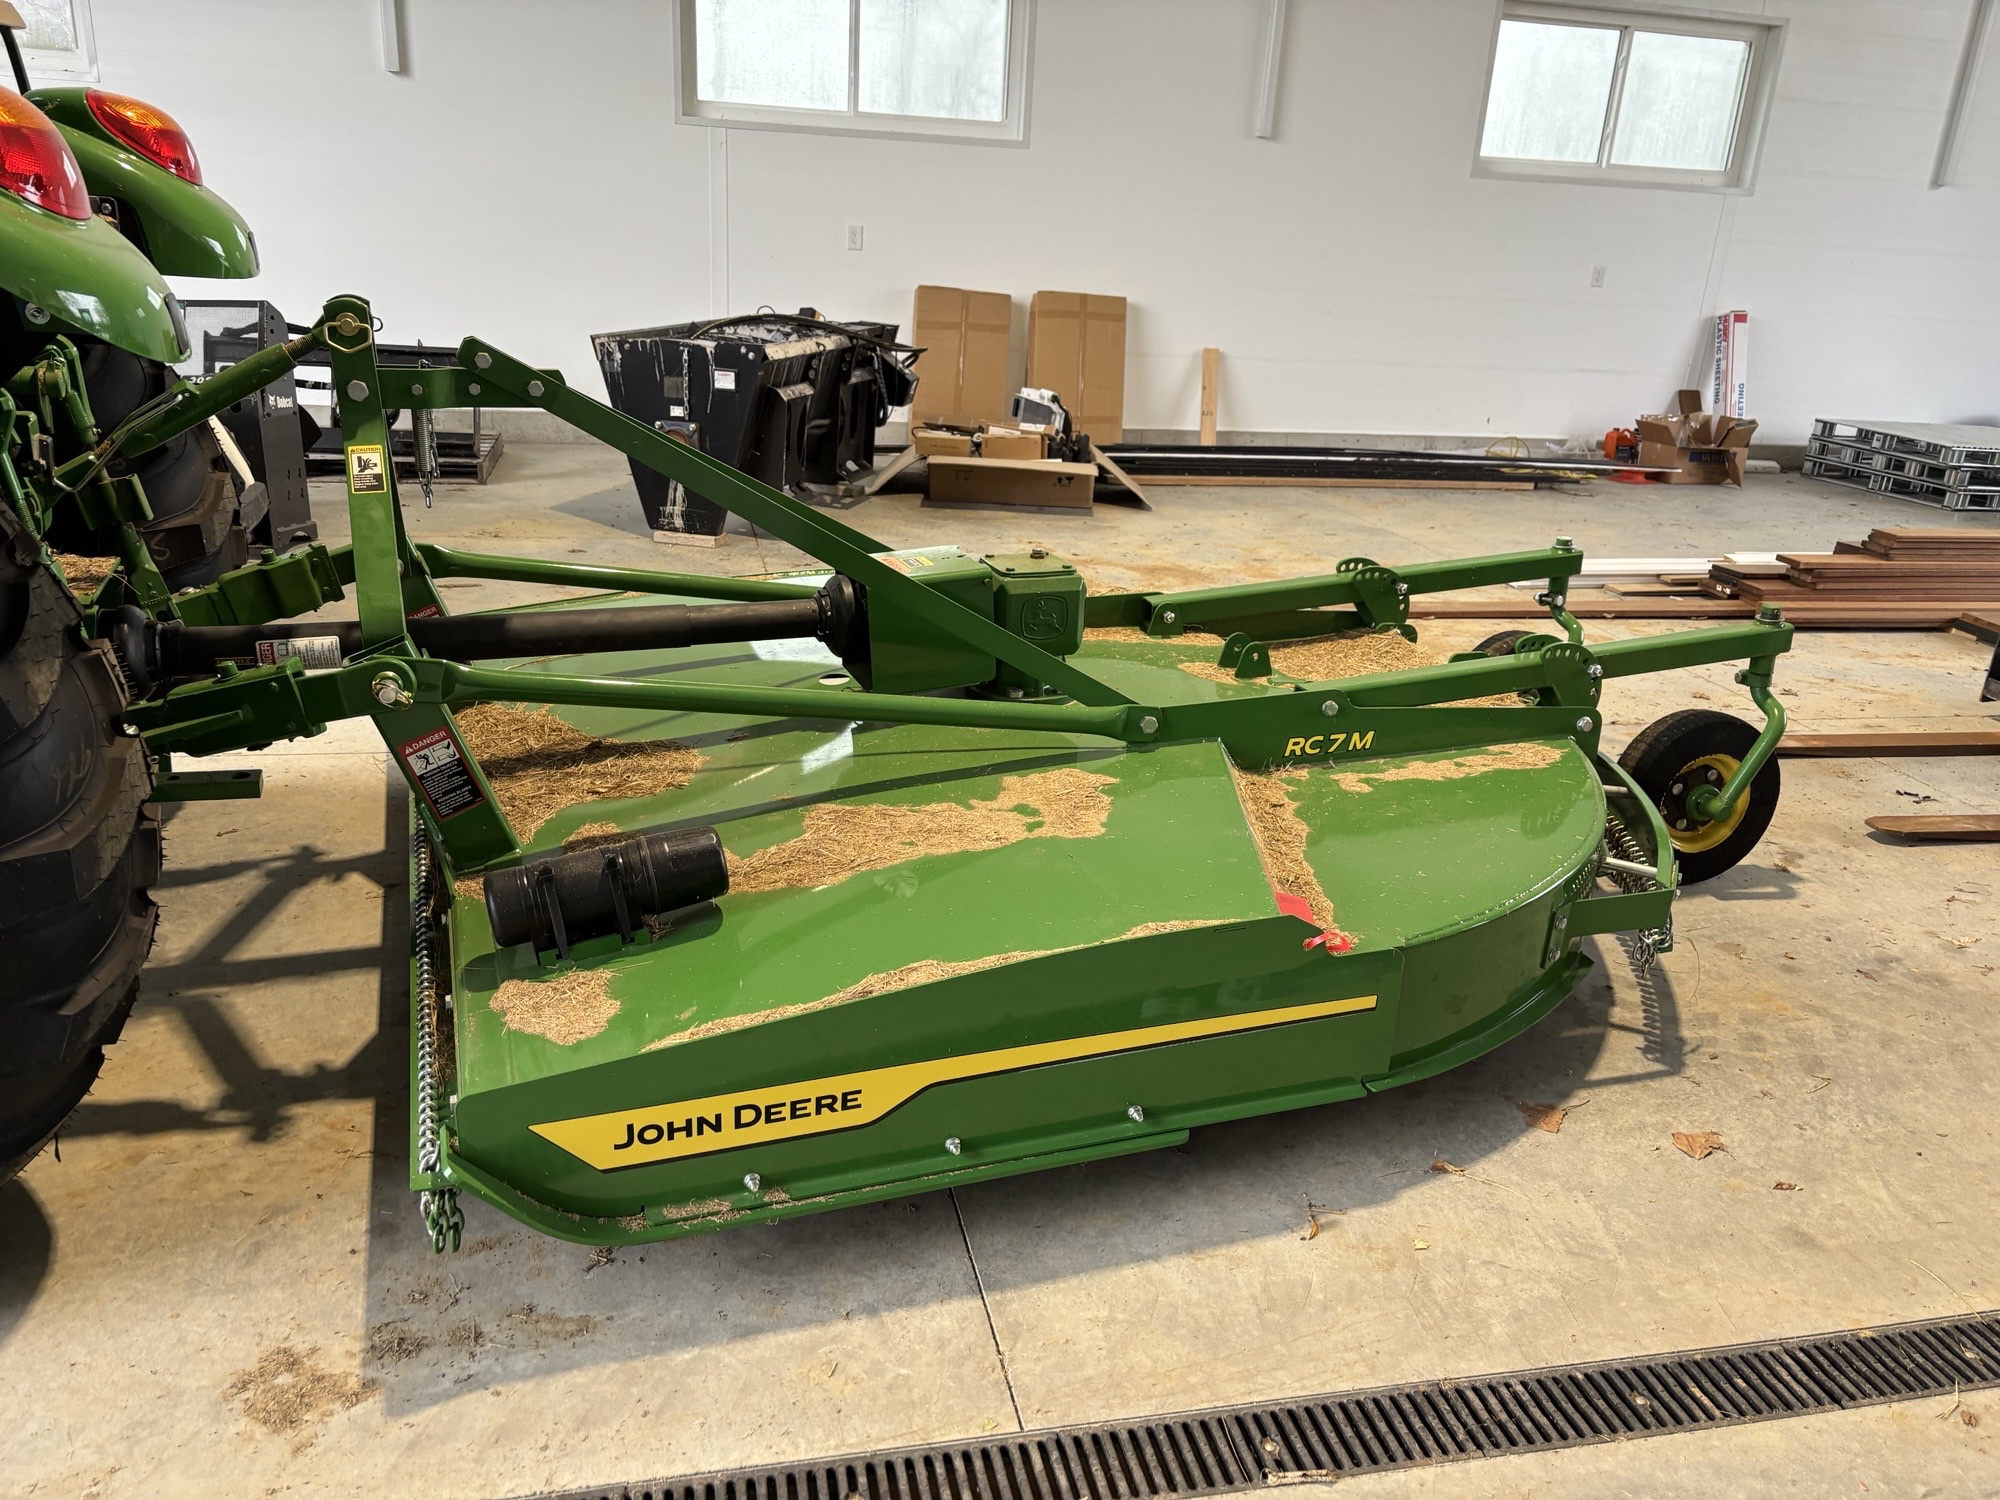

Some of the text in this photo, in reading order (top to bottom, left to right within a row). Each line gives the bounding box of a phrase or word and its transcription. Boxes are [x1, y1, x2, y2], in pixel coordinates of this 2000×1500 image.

[1714, 357, 1722, 404] SHEETING
[1737, 383, 1745, 420] EETING
[412, 731, 447, 750] DANGER
[613, 1089, 862, 1150] JOHN DEERE
